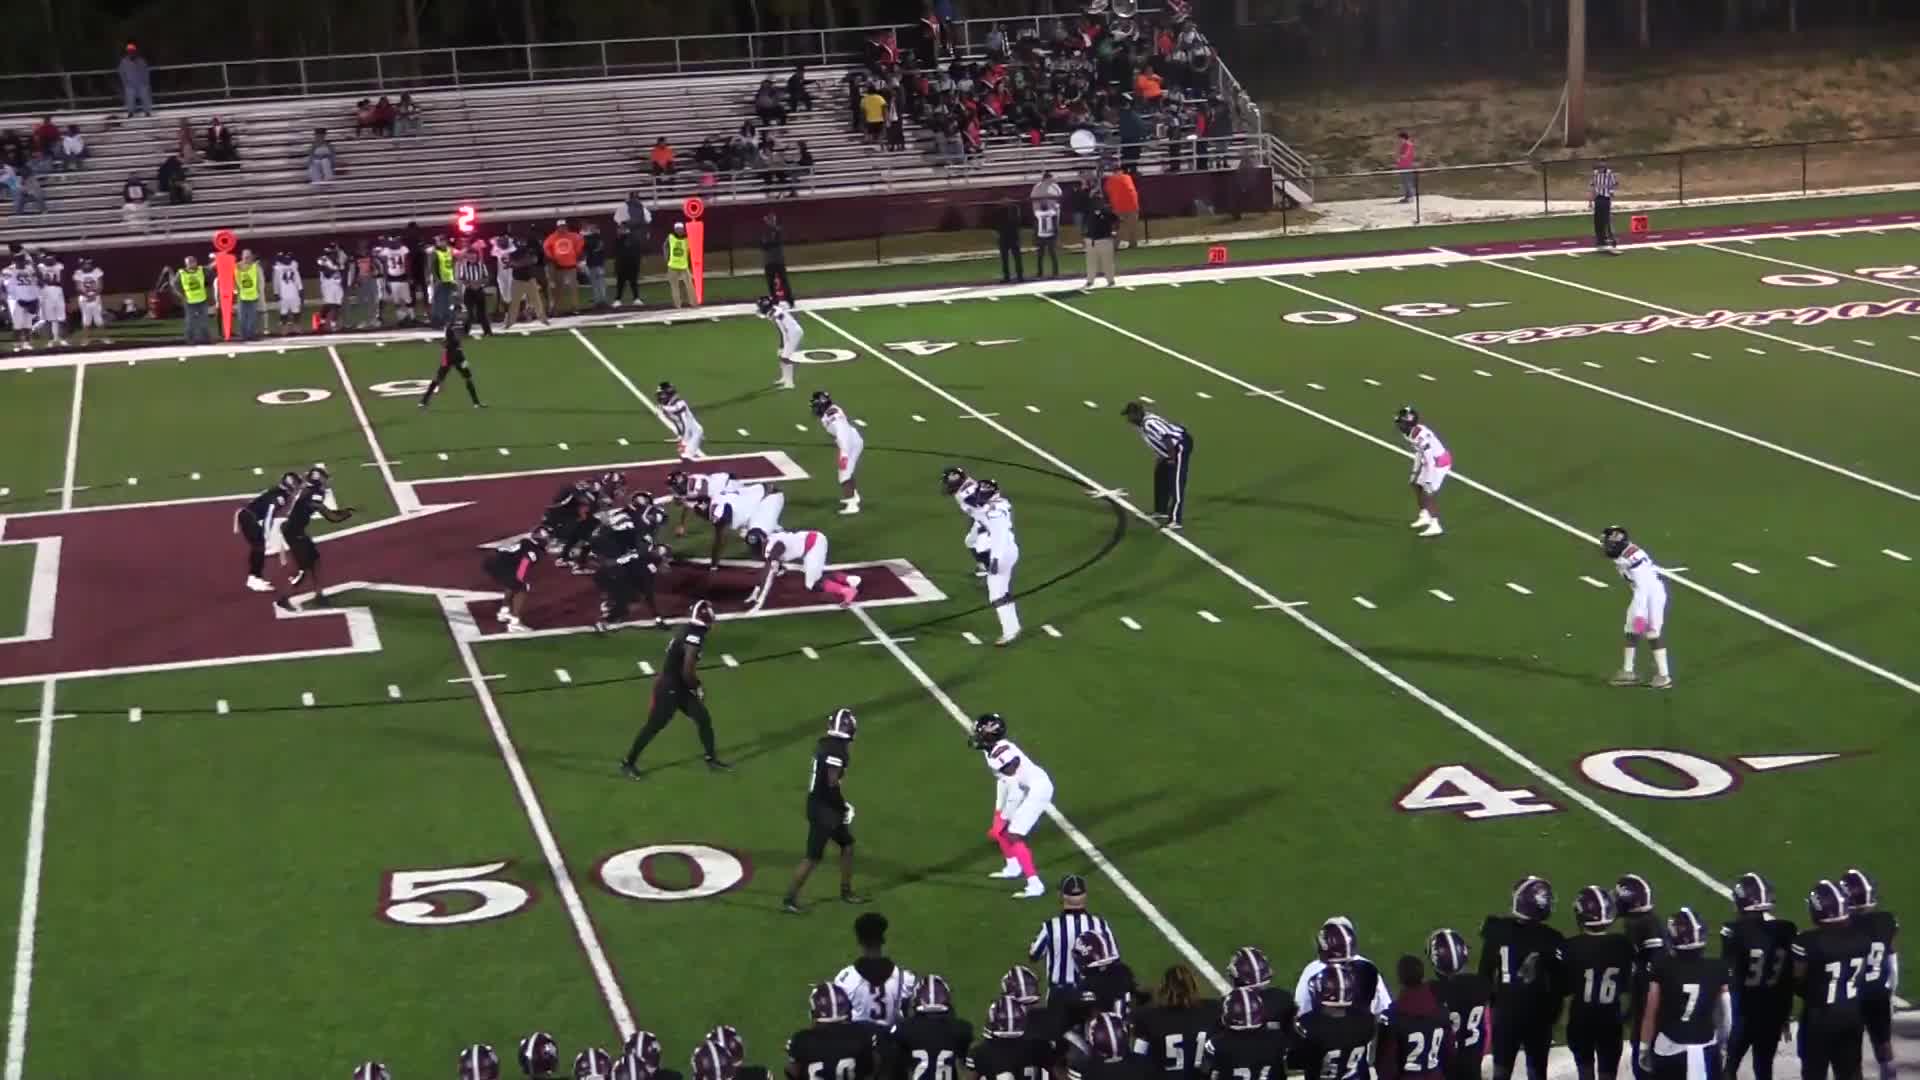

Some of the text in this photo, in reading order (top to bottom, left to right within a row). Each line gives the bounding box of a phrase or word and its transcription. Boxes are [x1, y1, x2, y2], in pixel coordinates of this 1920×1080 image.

[458, 206, 474, 232] 2
[869, 986, 886, 1019] 3
[1584, 967, 1620, 1004] 16
[1680, 984, 1700, 1021] 7
[1404, 1027, 1443, 1071] 28
